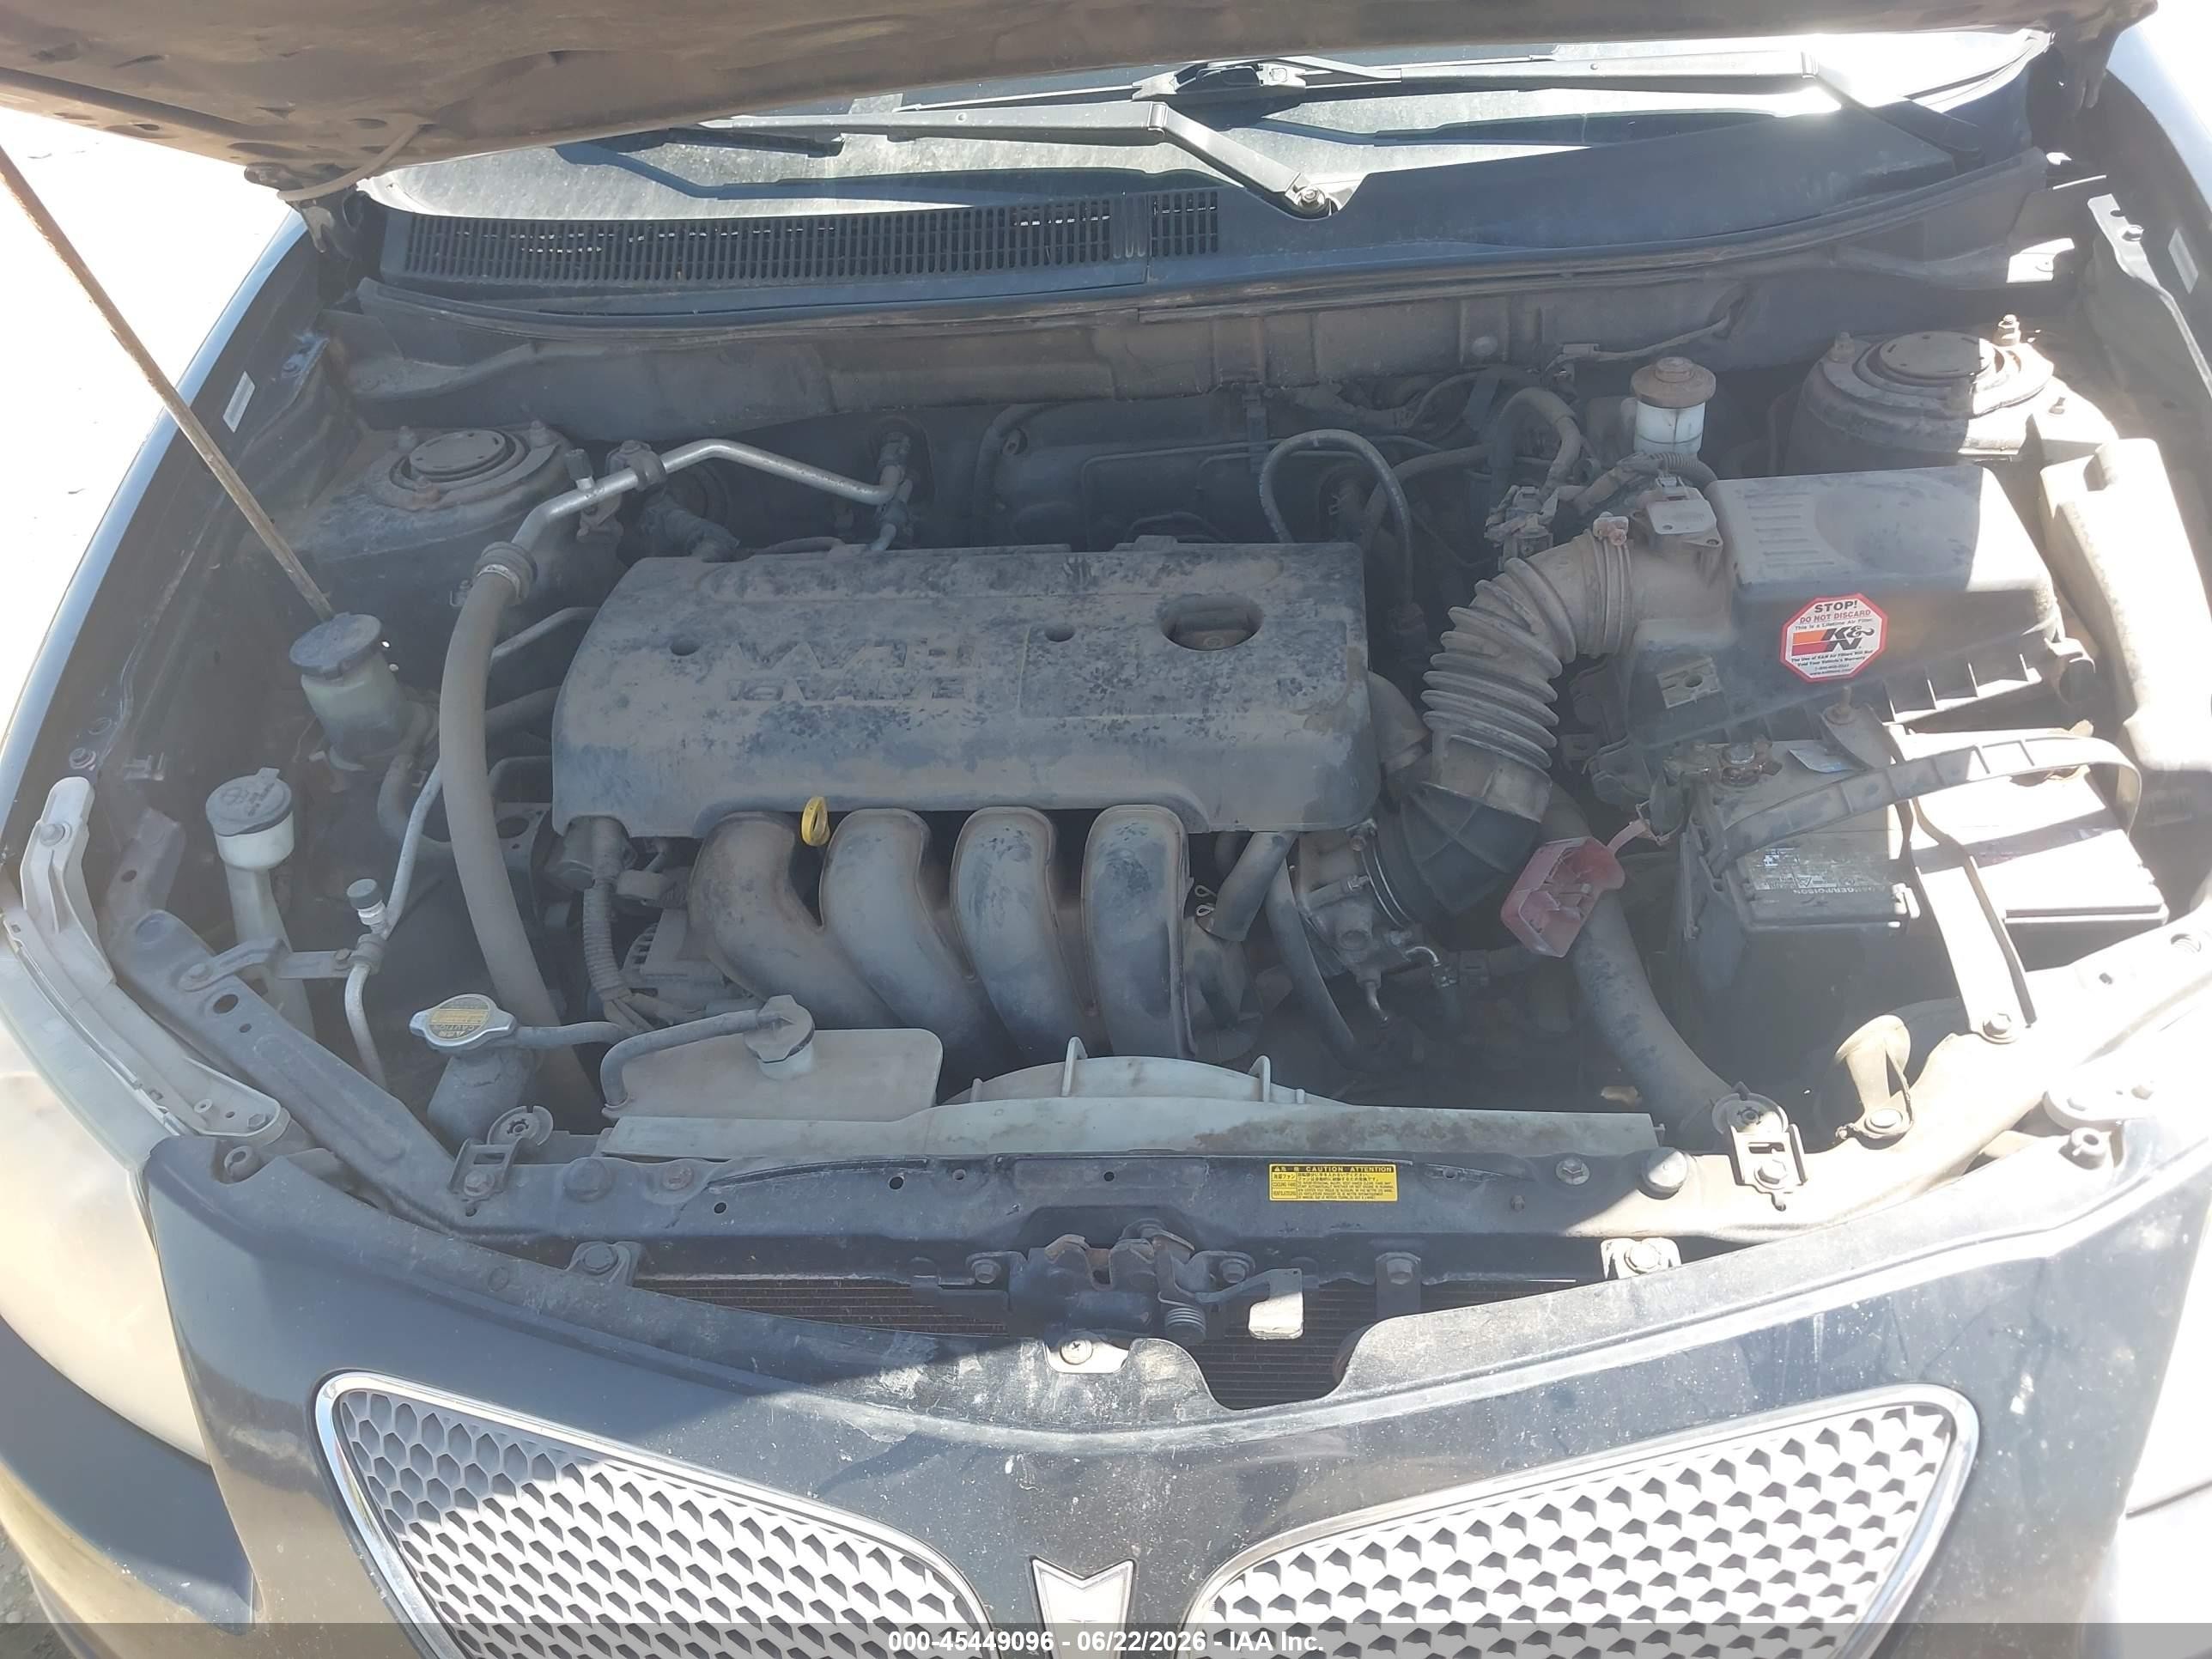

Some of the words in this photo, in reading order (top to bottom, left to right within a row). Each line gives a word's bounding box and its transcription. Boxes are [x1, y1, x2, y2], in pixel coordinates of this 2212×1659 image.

[1814, 600, 1857, 613] STOP!
[1814, 613, 1832, 623] NOT
[1833, 609, 1871, 619] DISCARD
